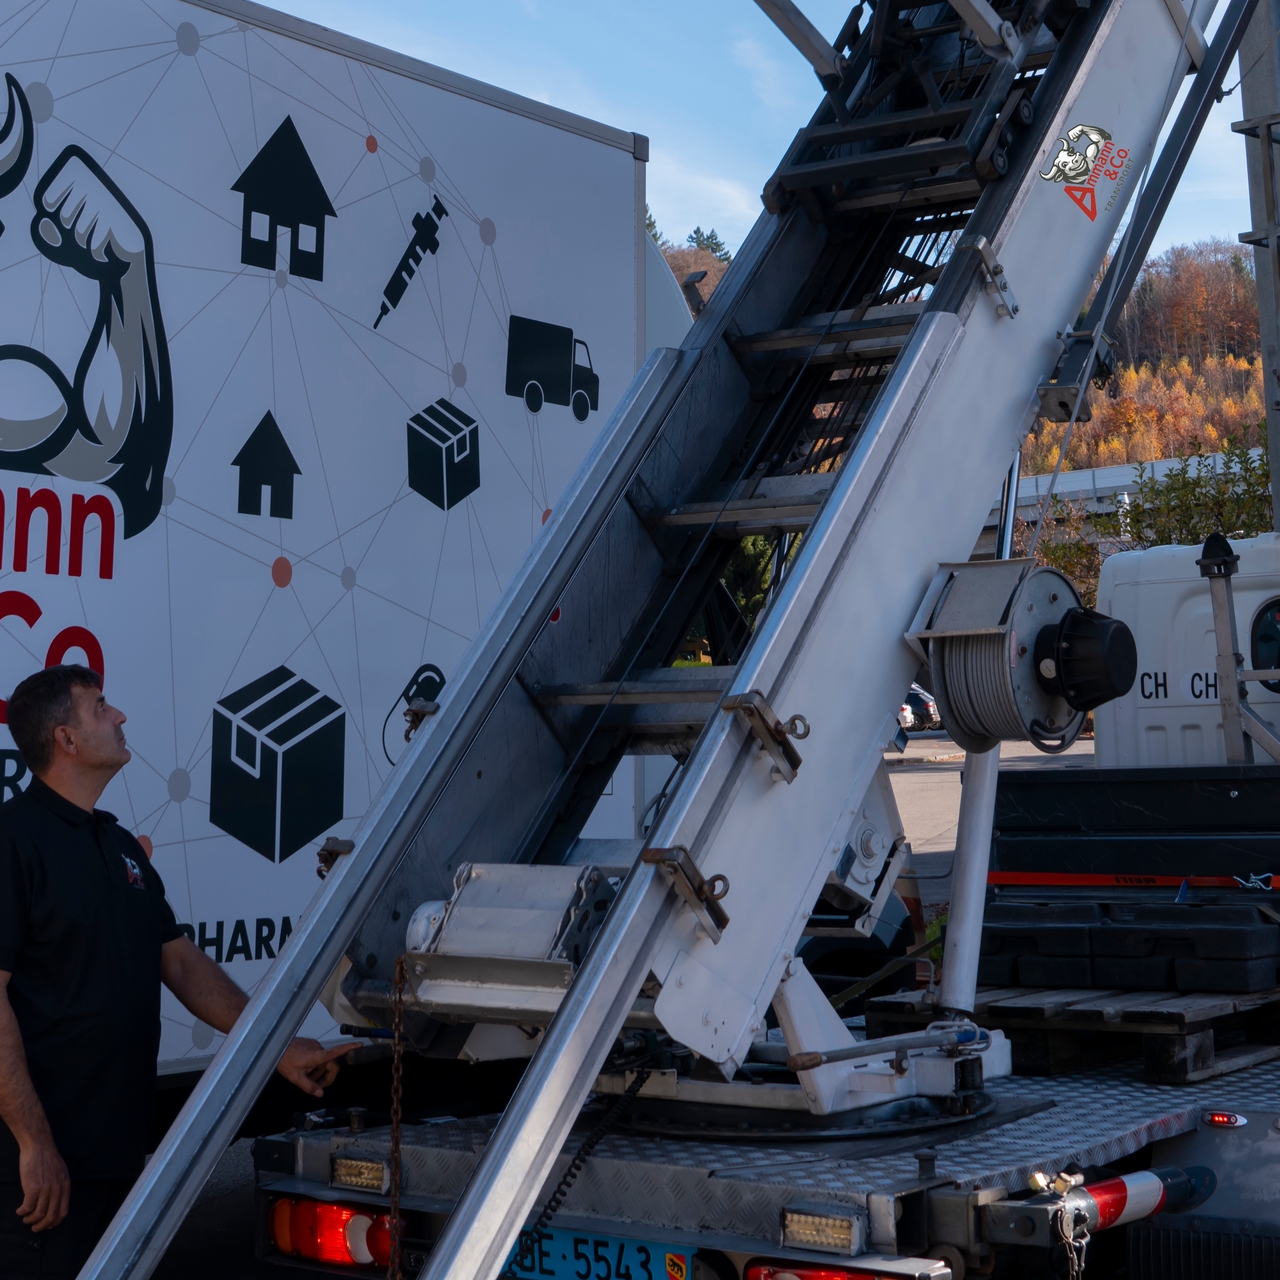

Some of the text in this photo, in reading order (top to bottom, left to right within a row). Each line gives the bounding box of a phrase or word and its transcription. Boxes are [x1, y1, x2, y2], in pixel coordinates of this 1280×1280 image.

[1064, 140, 1115, 222] Ammann
[1104, 158, 1134, 213] TRANSPORT
[1140, 671, 1168, 699] CH
[1190, 671, 1218, 699] CH
